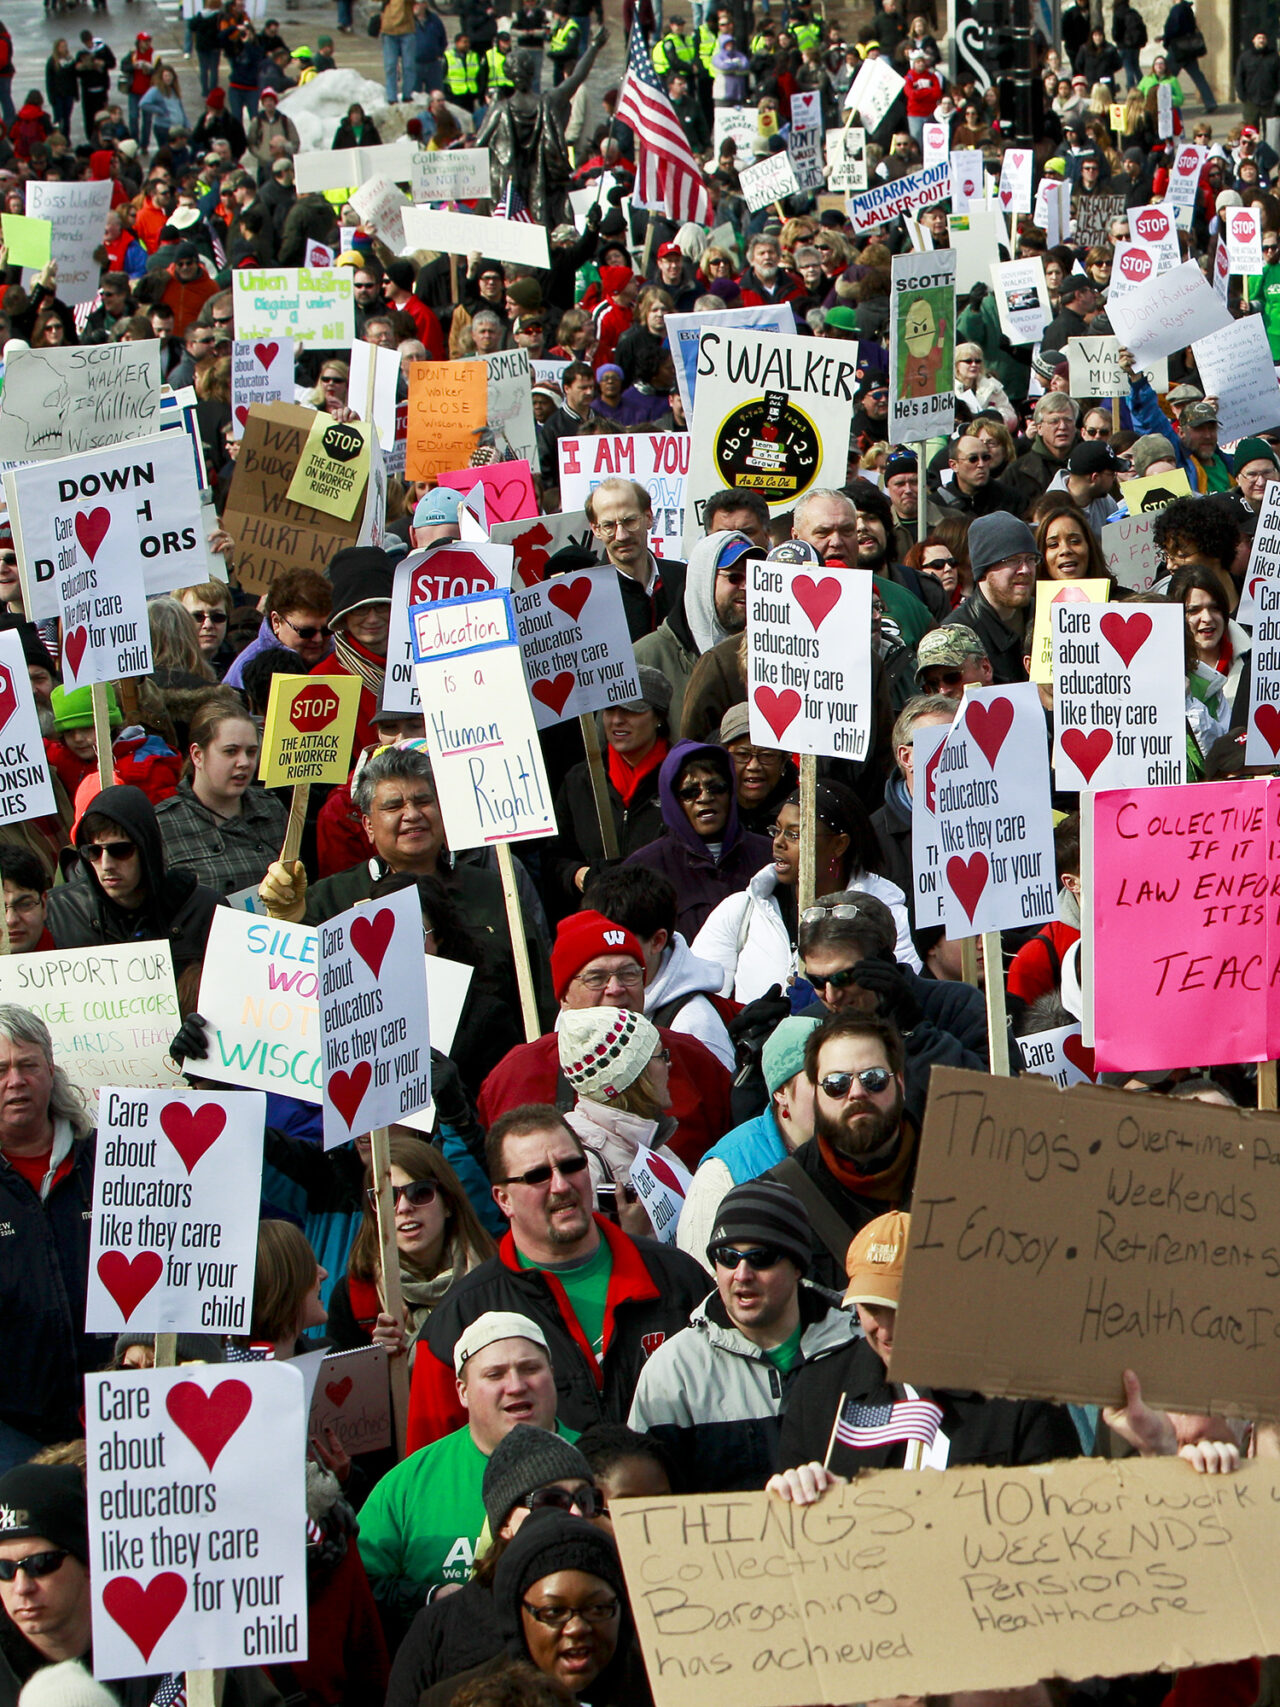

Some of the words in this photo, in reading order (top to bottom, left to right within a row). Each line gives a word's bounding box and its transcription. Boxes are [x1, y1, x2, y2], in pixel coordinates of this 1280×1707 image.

[838, 164, 856, 173] JOBS
[1177, 155, 1197, 170] STOP
[852, 163, 948, 213] MUBARAK-OUT!
[855, 180, 951, 228] WALKER-OUT!
[1137, 218, 1168, 233] STOP
[1232, 221, 1255, 234] STOP
[311, 249, 330, 264] STOP
[1121, 257, 1151, 272] STOP
[70, 344, 132, 368] SCOTT
[698, 333, 720, 377] S.
[727, 340, 854, 401] WALKER
[88, 363, 151, 390] WALKER
[454, 369, 475, 382] LET
[417, 401, 471, 414] CLOSE
[894, 400, 918, 420] He's
[922, 405, 928, 414] a
[931, 395, 954, 411] Dick
[325, 429, 364, 456] STOP
[563, 440, 580, 474] I
[594, 436, 636, 474] AM
[58, 462, 154, 502] DOWN
[242, 516, 304, 551] HURT
[418, 606, 501, 653] Education
[443, 670, 457, 693] is
[473, 670, 485, 686] a
[292, 698, 339, 718] STOP
[431, 710, 502, 752] Human
[1188, 840, 1219, 861] IF
[1232, 840, 1254, 861] IT
[1116, 878, 1180, 906] LAW
[17, 957, 118, 988] SUPPORT
[83, 994, 177, 1023] COLLECTORS
[241, 995, 319, 1036] NOT
[936, 1090, 1081, 1182] Things
[1106, 1168, 1257, 1221] Weekends
[913, 1197, 956, 1251] I
[953, 1479, 1034, 1526] 40
[963, 1515, 1233, 1568] WEEKENDS
[642, 1587, 898, 1635] Bargaining
[655, 1648, 732, 1678] has
[752, 1634, 913, 1671] achieved
